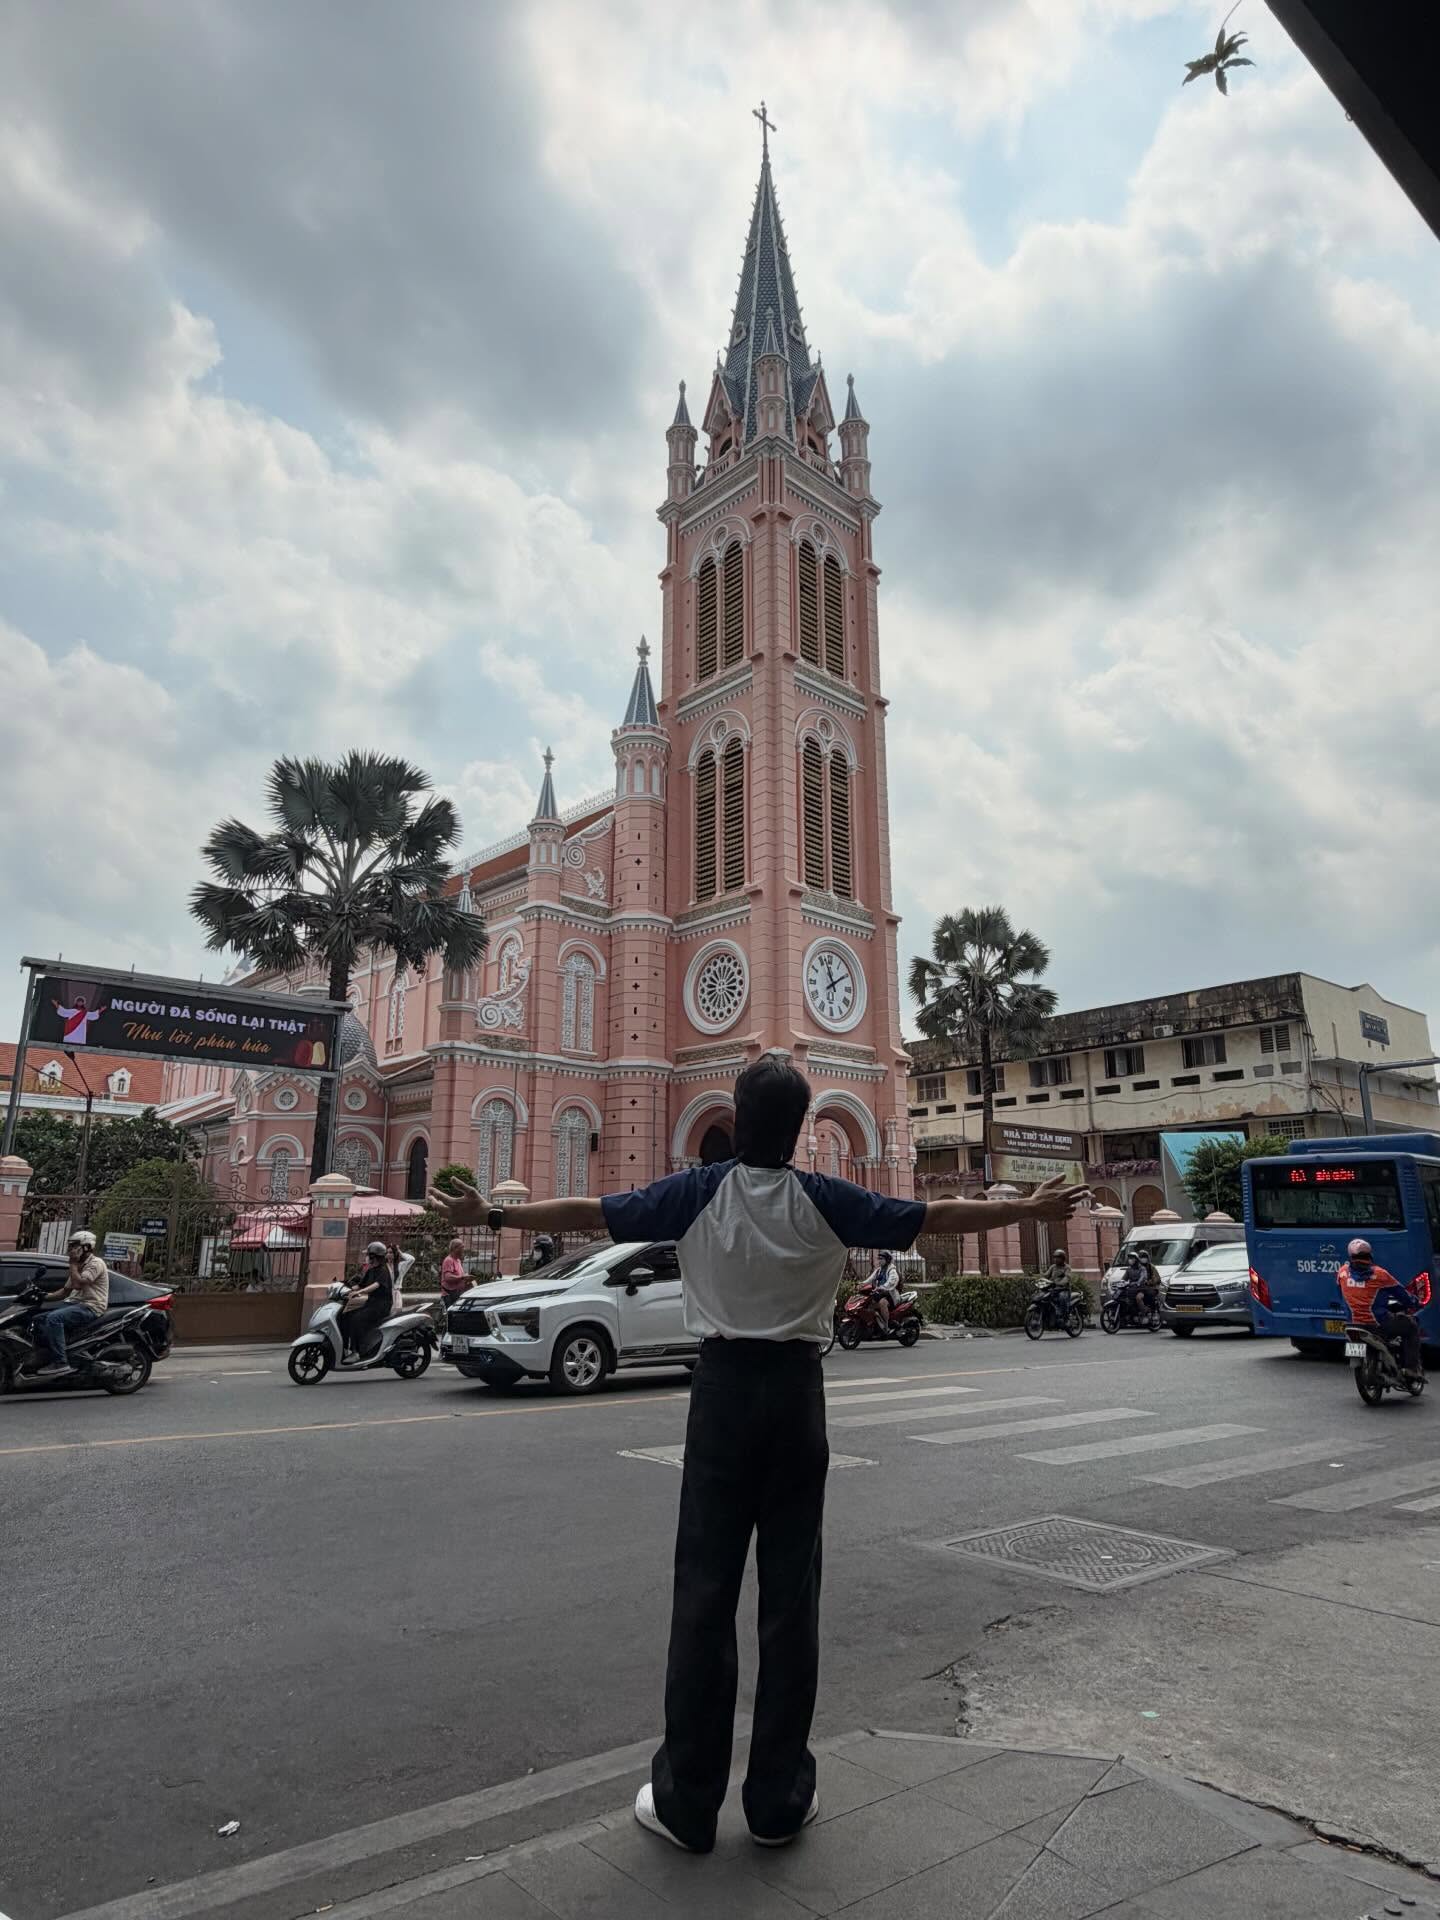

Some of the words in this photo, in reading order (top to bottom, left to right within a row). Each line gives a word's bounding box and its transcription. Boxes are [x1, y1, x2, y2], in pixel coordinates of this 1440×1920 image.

[110, 998, 166, 1016] NGƯỜI
[169, 1005, 191, 1019] ĐÃ
[195, 1007, 237, 1025] SỐNG
[241, 1015, 265, 1030] LẠI
[268, 1018, 306, 1034] THẬT
[122, 1022, 164, 1040] Như
[168, 1028, 193, 1045] lời
[193, 1032, 237, 1050] phán
[1003, 1129, 1021, 1139] NHÀ
[1022, 1130, 1037, 1140] THỜ
[1038, 1132, 1054, 1142] TÂN
[1054, 1135, 1073, 1144] ĐỊNH
